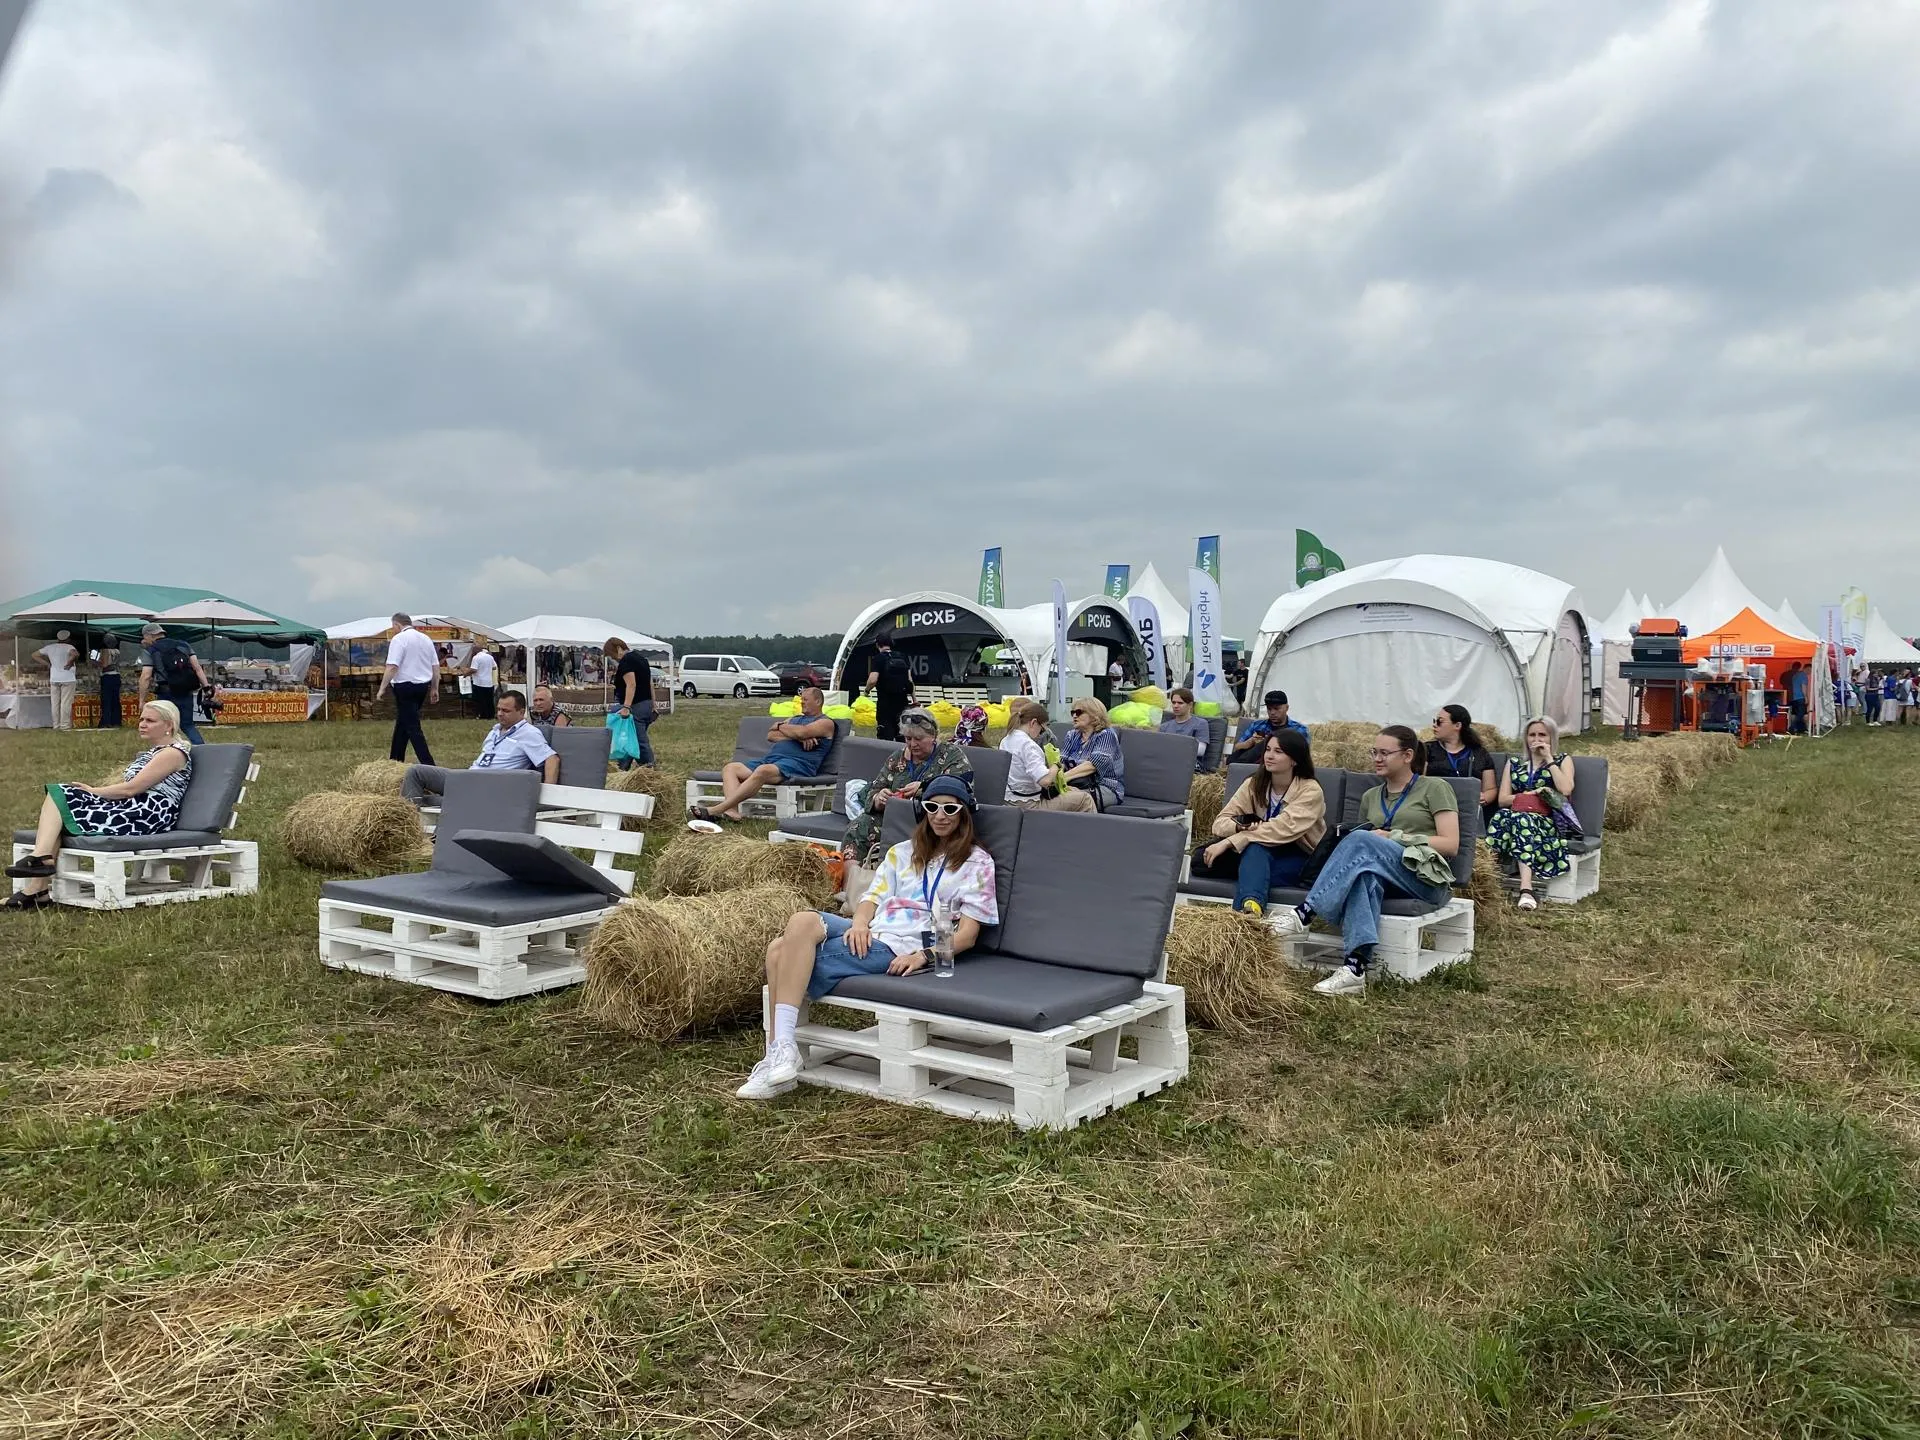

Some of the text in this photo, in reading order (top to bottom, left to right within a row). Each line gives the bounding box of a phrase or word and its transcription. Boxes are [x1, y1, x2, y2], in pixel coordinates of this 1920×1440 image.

[911, 609, 956, 627] РСХБ
[1088, 614, 1111, 628] РСХБ
[908, 655, 930, 675] ХБ
[223, 702, 305, 714] УЛЬСКИЕ ПРЯНИКИ
